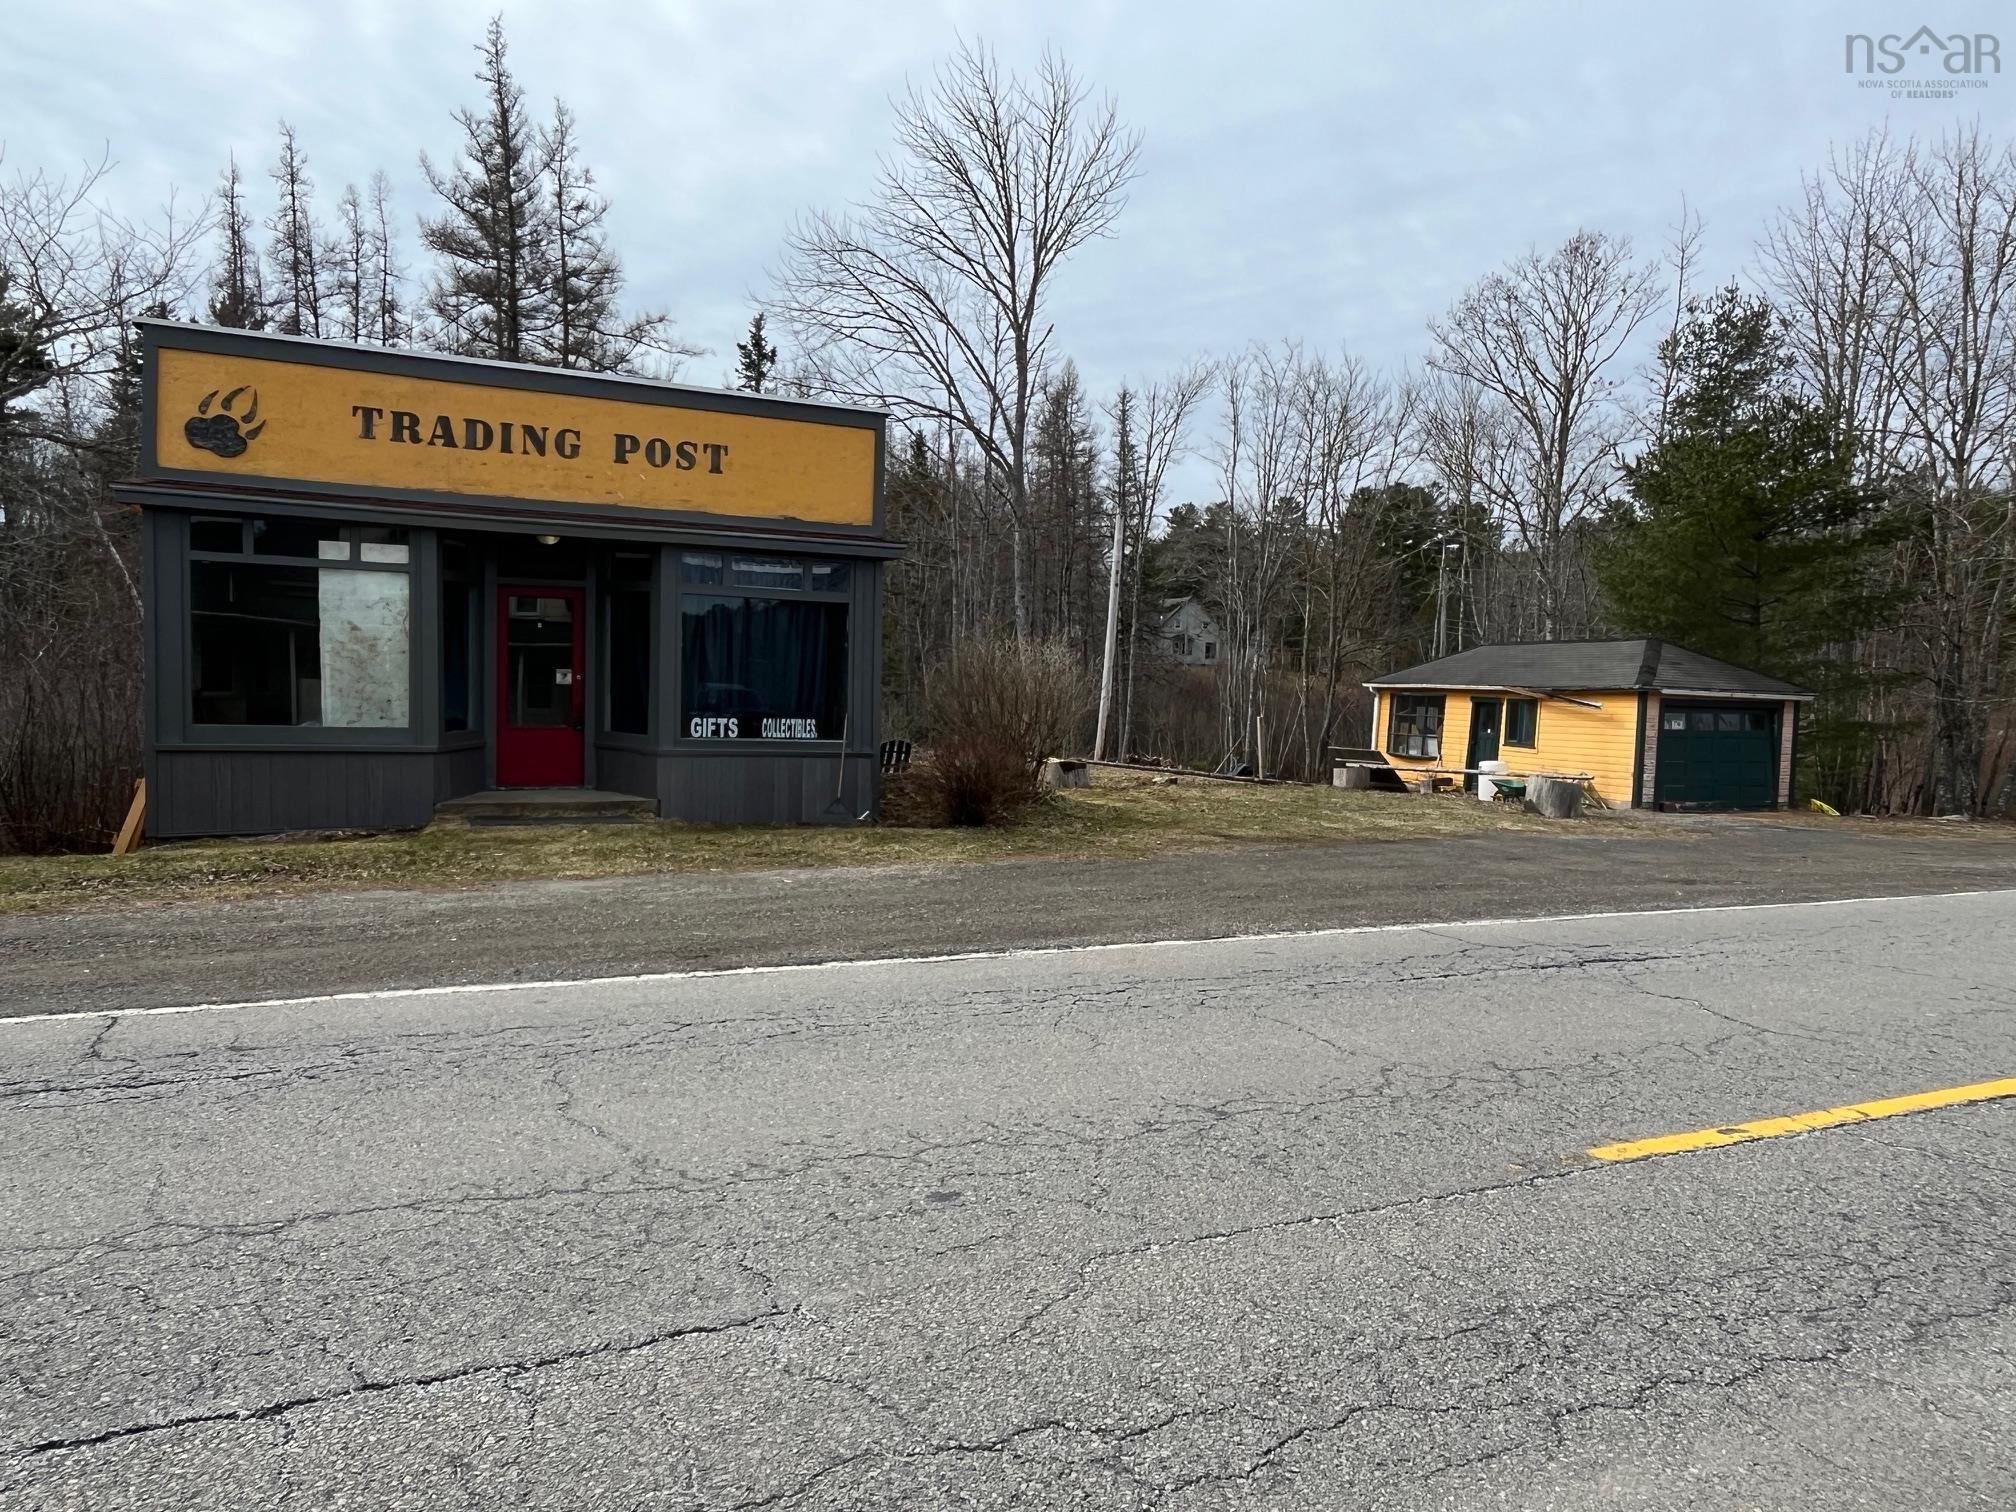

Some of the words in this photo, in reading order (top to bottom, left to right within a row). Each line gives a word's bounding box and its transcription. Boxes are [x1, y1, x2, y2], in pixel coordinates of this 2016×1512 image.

[352, 405, 581, 459] TRADING
[613, 433, 728, 474] POST
[690, 717, 738, 738] GIFTS
